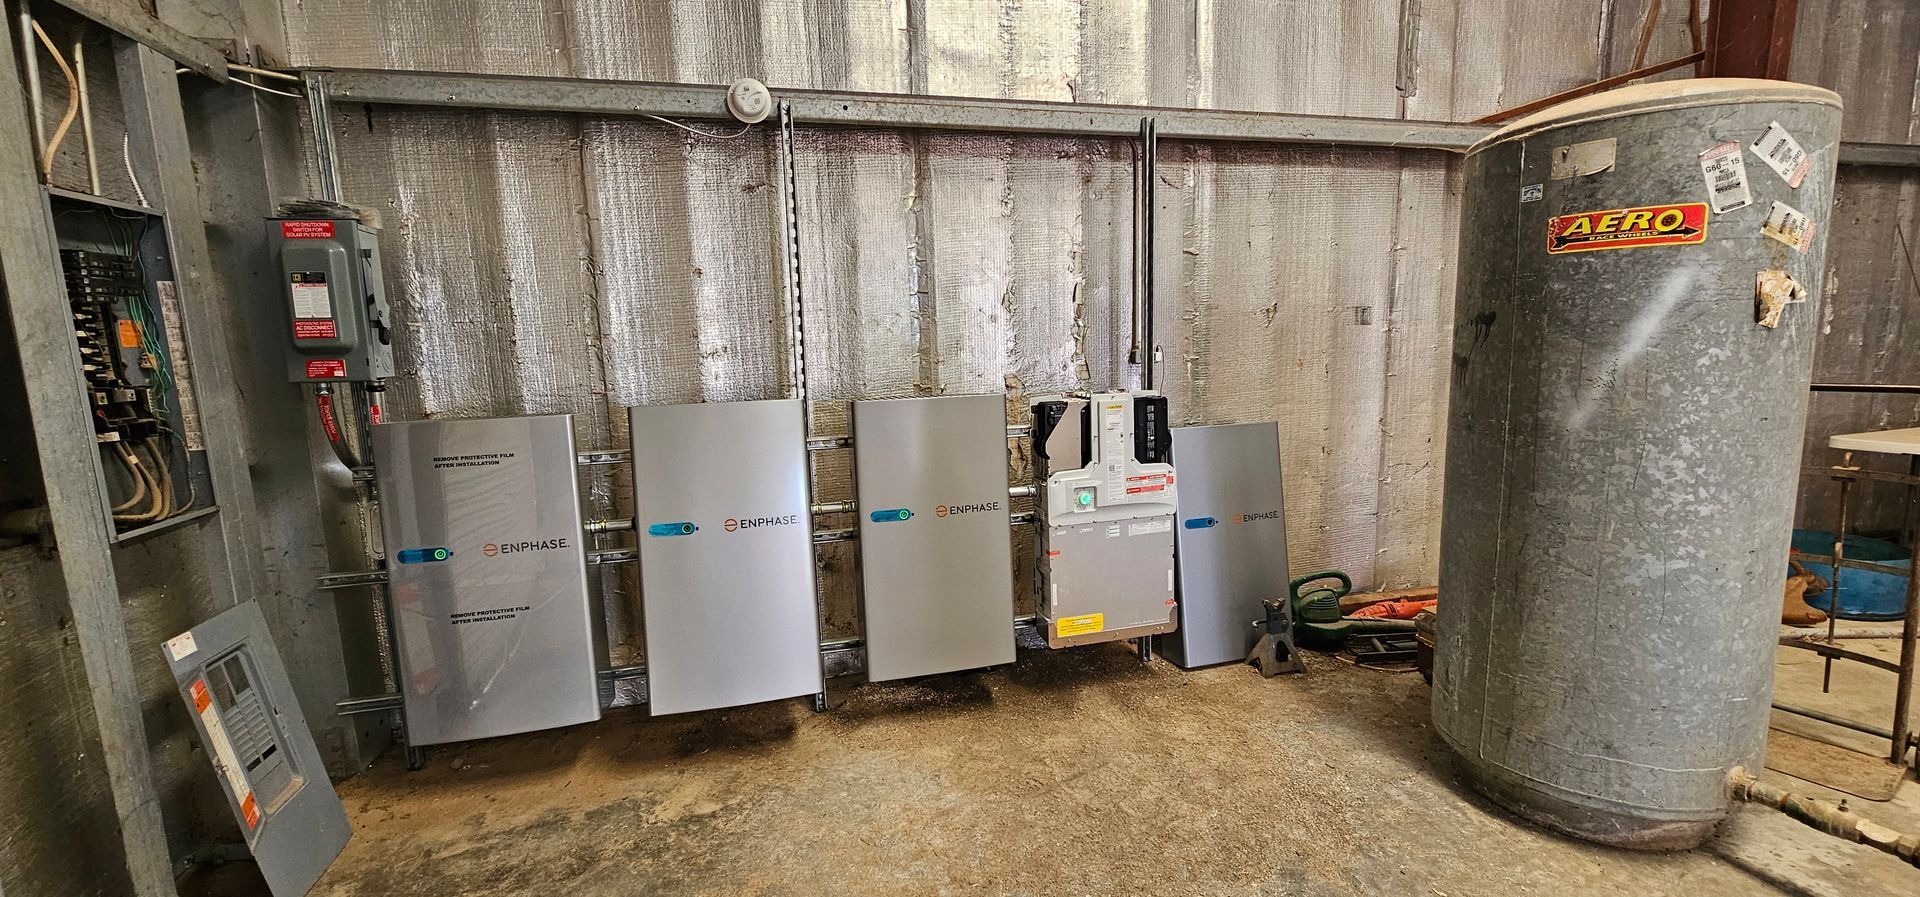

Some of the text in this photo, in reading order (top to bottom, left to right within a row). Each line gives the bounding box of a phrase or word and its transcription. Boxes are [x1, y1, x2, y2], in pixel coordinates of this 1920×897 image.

[1705, 163, 1722, 174] G60
[1730, 157, 1741, 166] 15
[1562, 209, 1684, 236] AERO
[1616, 230, 1660, 239] WHEELS
[472, 614, 515, 622] INSTALLATION
